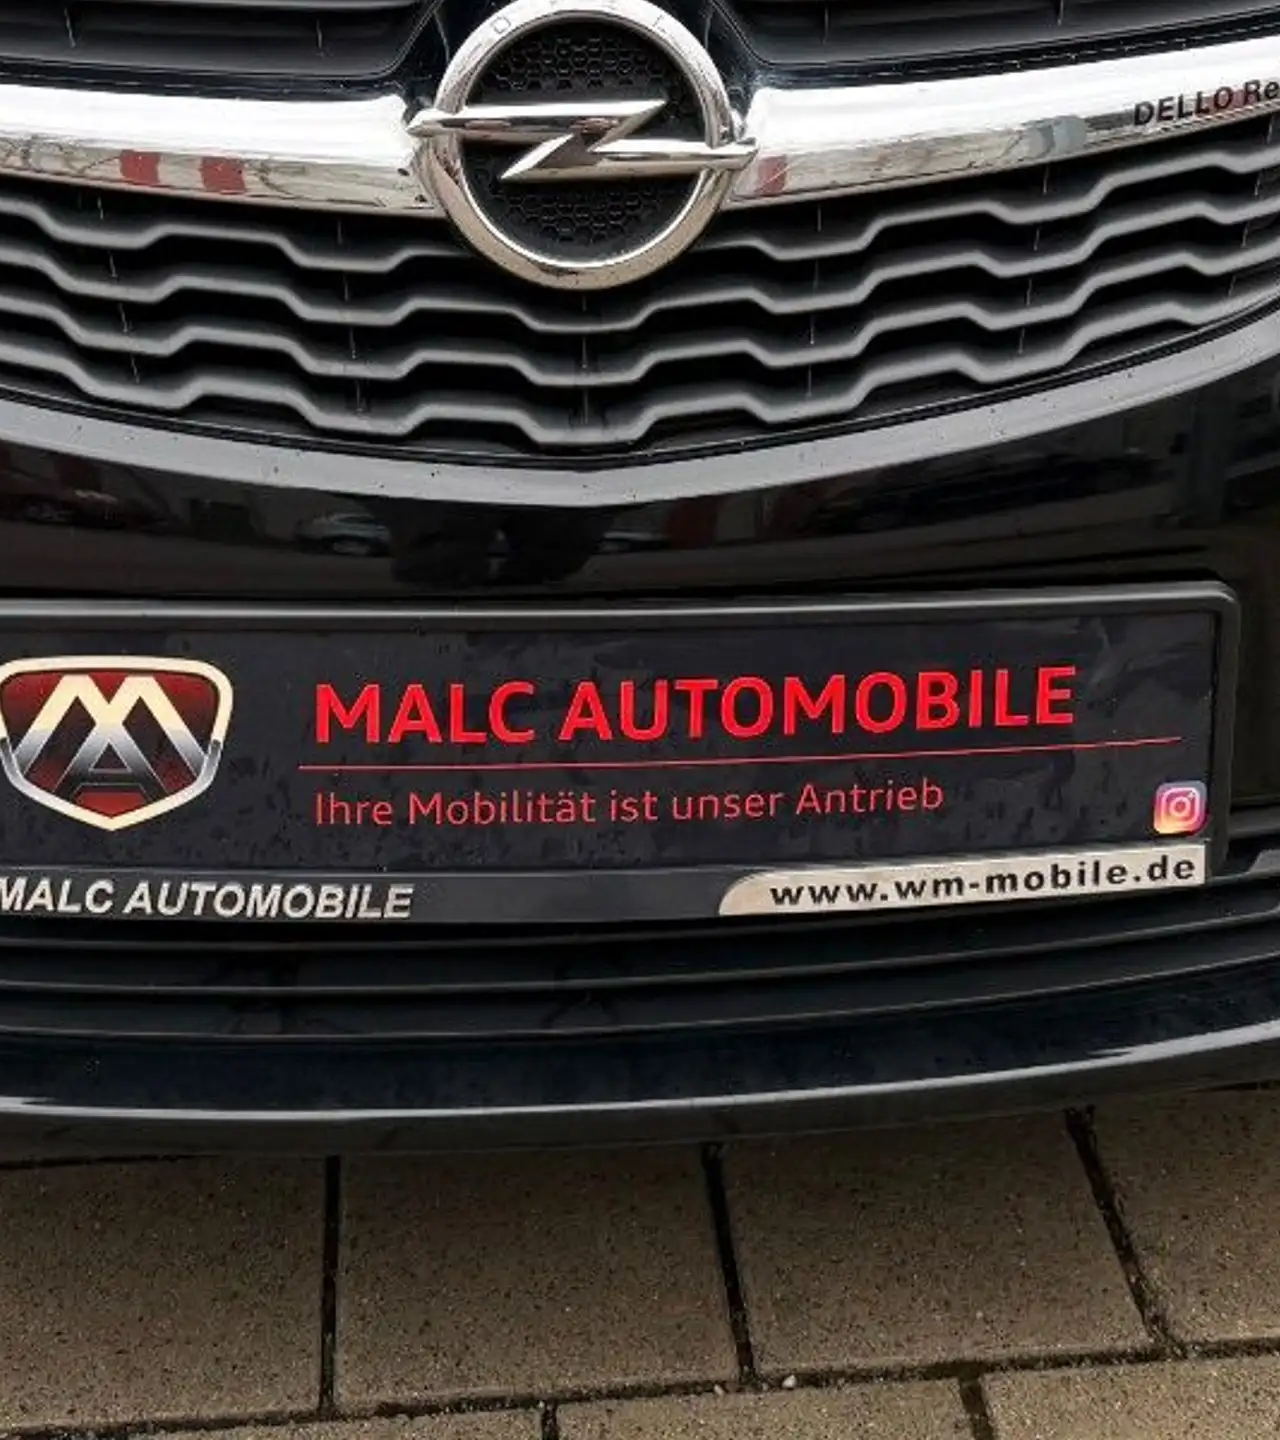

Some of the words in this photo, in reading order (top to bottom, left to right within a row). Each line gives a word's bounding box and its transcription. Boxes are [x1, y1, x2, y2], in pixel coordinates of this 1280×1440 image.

[1133, 86, 1234, 126] DELLO
[314, 680, 536, 745] MALC
[558, 664, 1077, 742] AUTOMOBILE
[315, 791, 394, 826] Ihre
[407, 787, 598, 826] Mobilität
[609, 788, 659, 822] ist
[671, 791, 785, 821] unser
[795, 776, 945, 816] Antrieb
[121, 880, 415, 920] AUTOMOBILE
[769, 853, 1196, 907] www.wm-mobile.de
